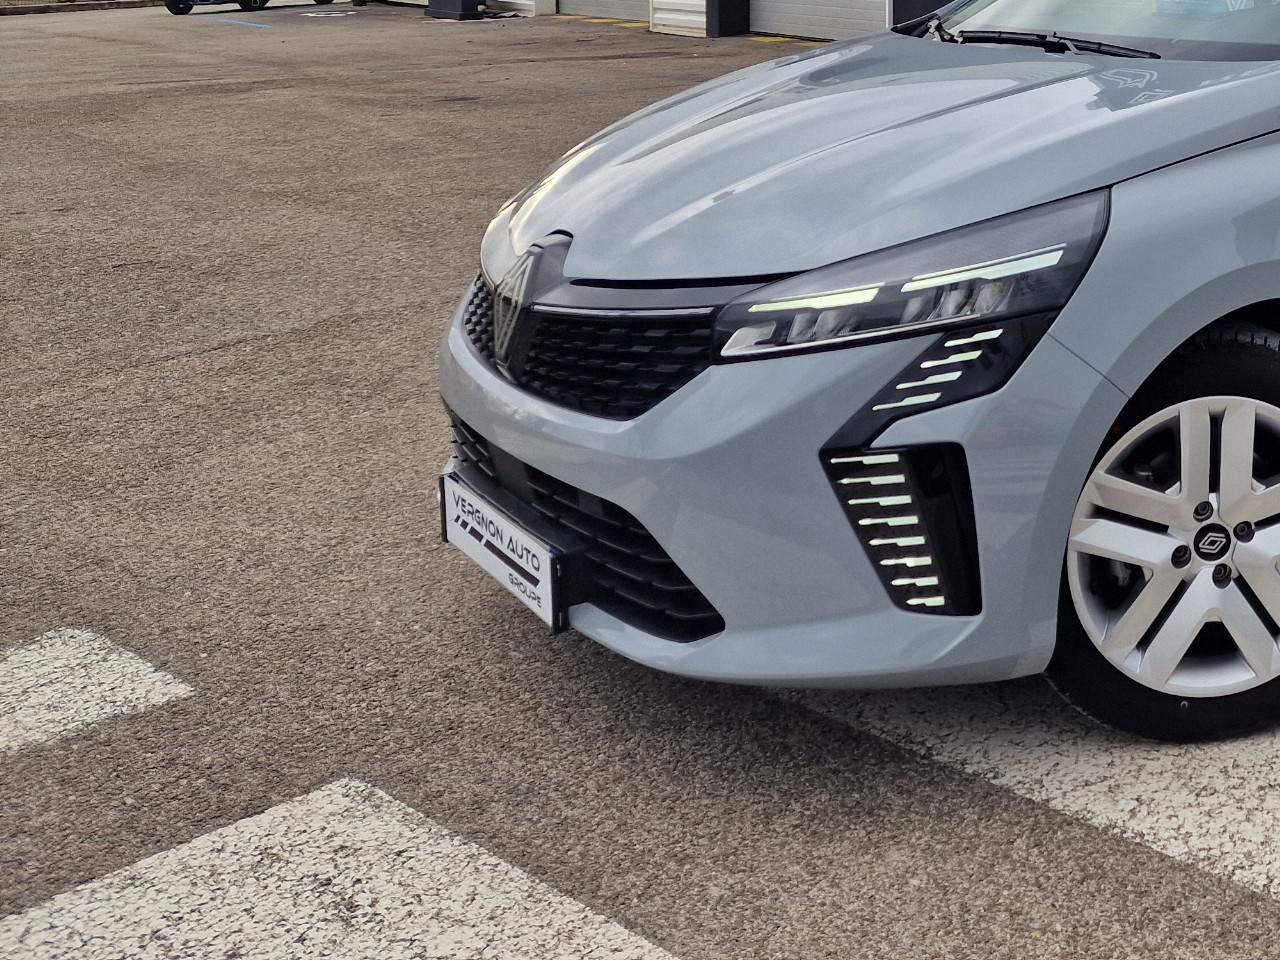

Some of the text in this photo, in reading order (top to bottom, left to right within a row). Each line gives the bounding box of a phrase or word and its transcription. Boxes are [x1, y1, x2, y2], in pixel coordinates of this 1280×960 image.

[452, 490, 541, 572] VERGNON AUTO
[508, 573, 542, 608] GROUPE
